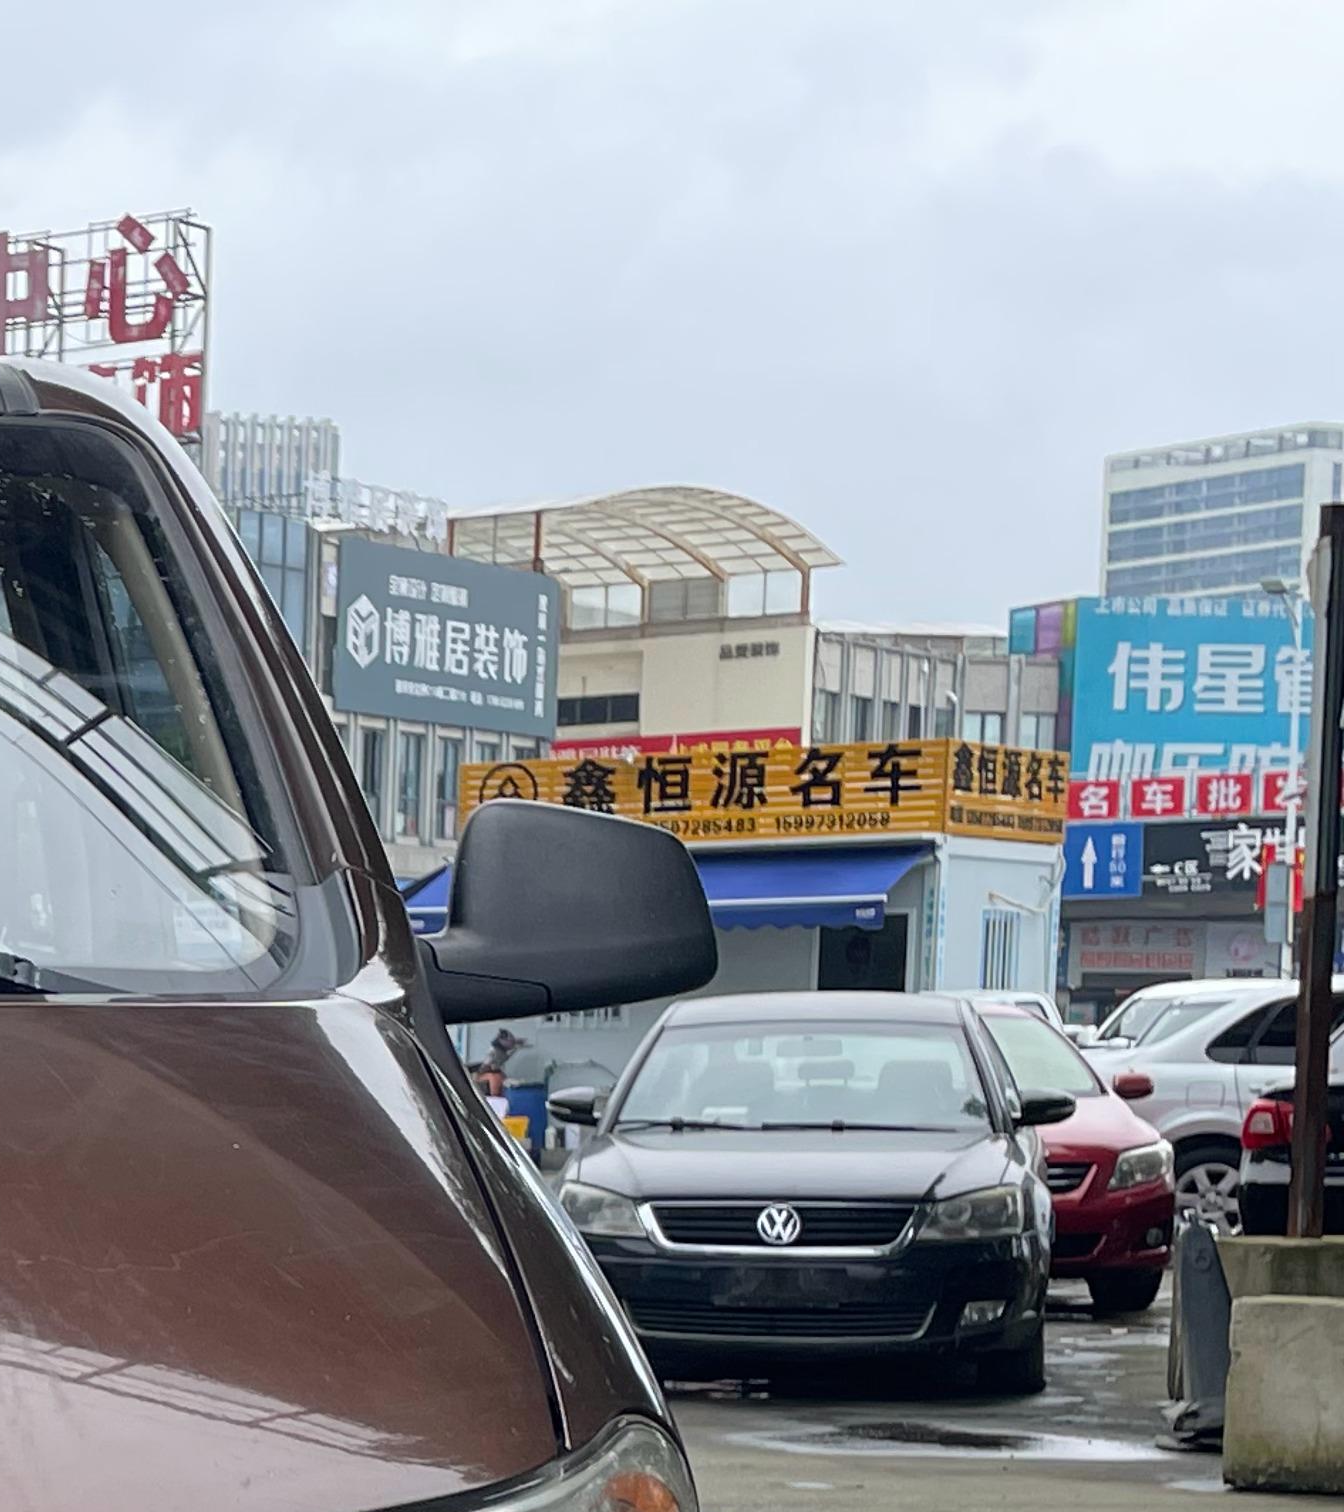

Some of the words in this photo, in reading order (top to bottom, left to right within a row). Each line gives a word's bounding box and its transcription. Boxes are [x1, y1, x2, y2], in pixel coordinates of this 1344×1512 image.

[384, 606, 528, 685] 博雅居装饰
[561, 743, 923, 814] 鑫恒源名车
[953, 743, 1066, 804] 鑫恒源名车
